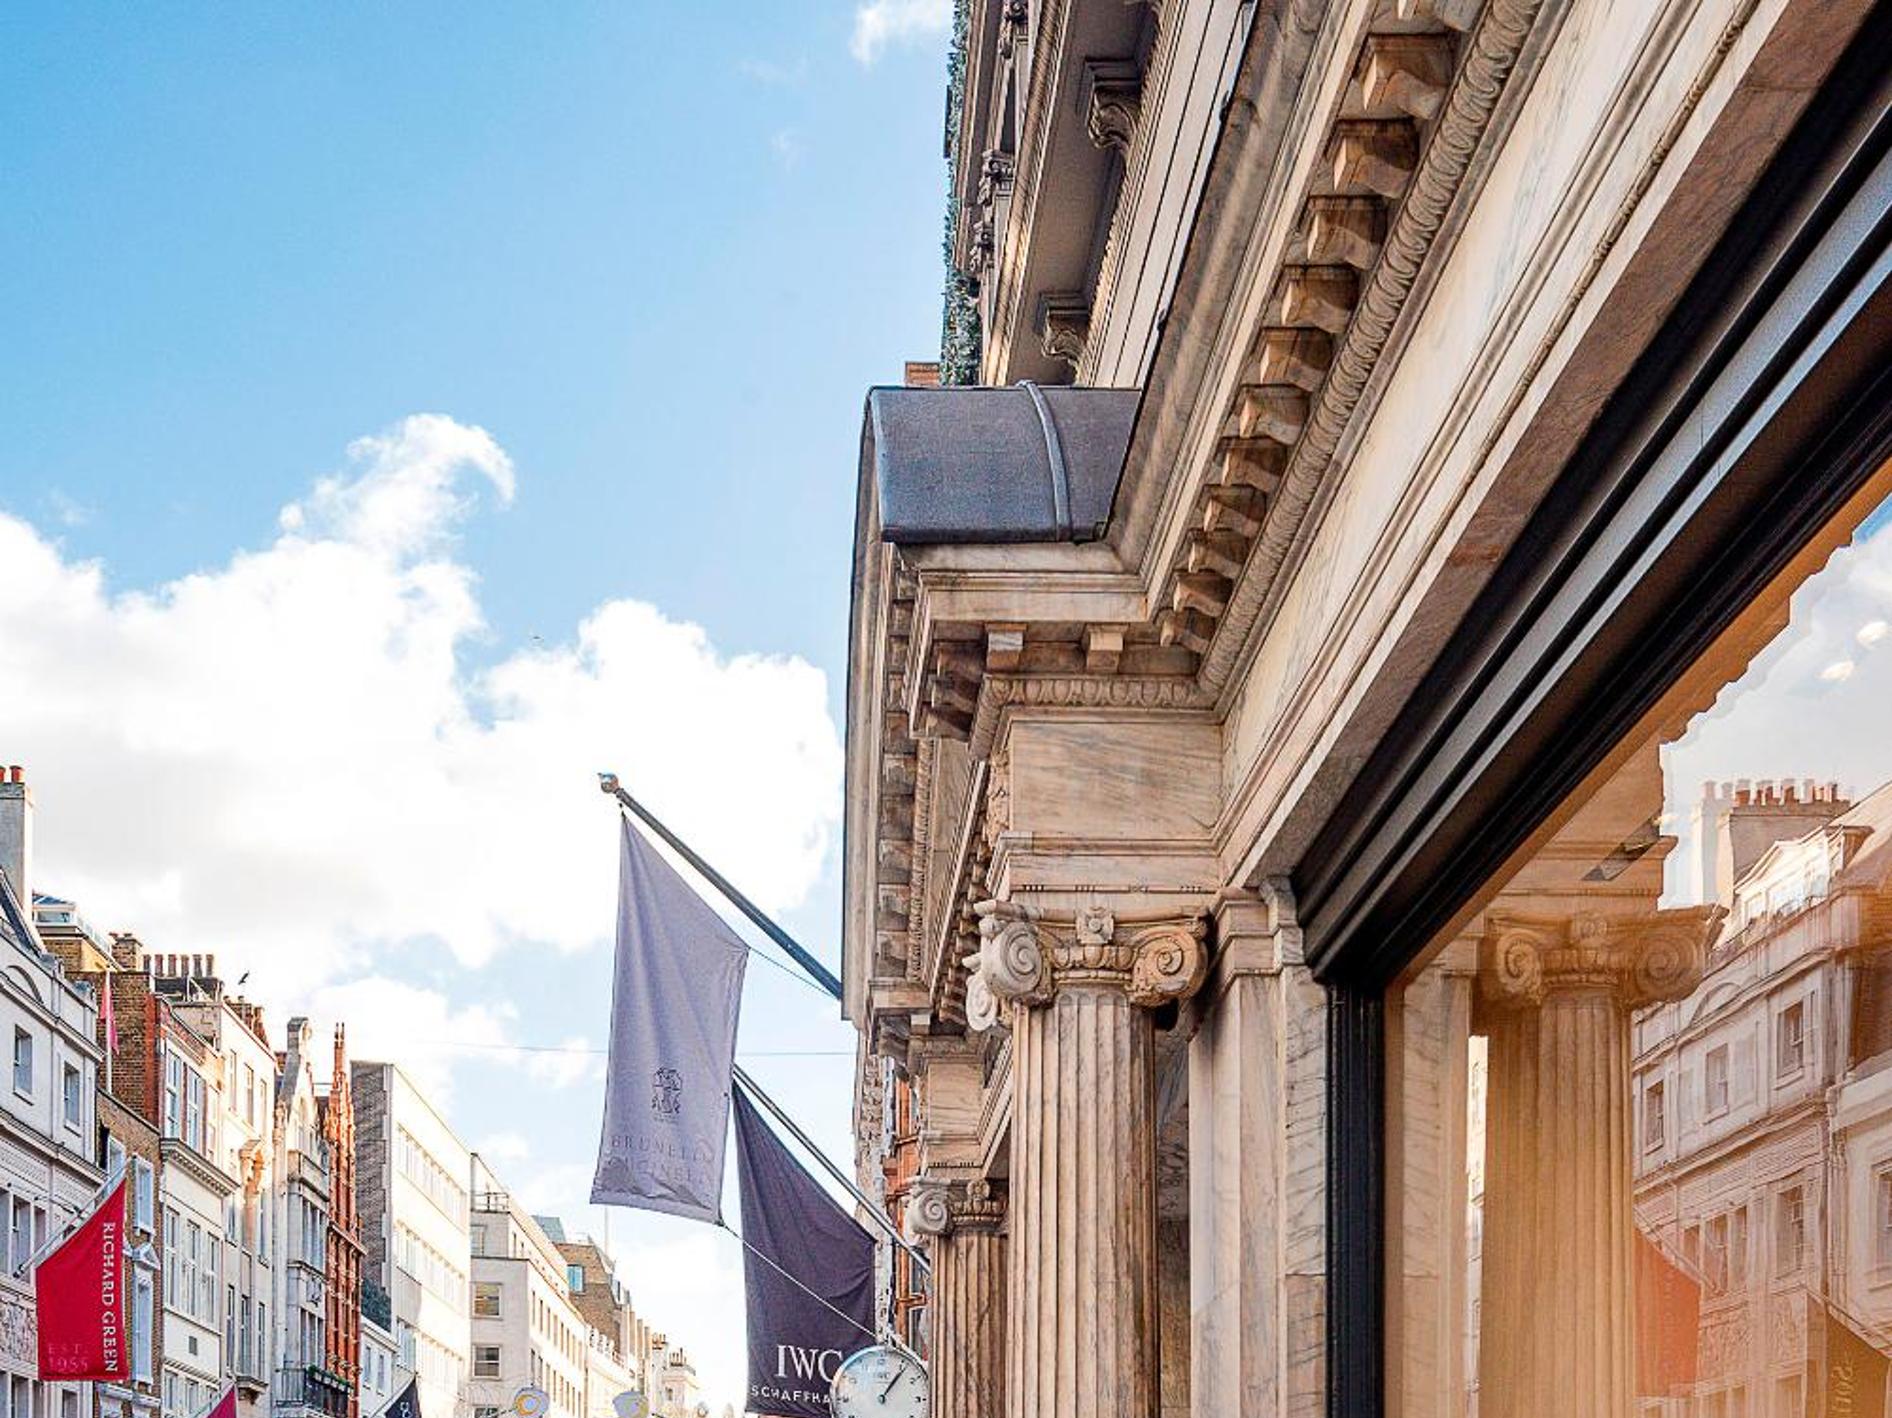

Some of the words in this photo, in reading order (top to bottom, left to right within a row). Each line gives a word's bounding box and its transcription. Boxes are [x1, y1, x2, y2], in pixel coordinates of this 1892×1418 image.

[101, 1222, 116, 1306] RICHARD
[101, 1311, 119, 1372] GREEN
[774, 1344, 843, 1383] IWC
